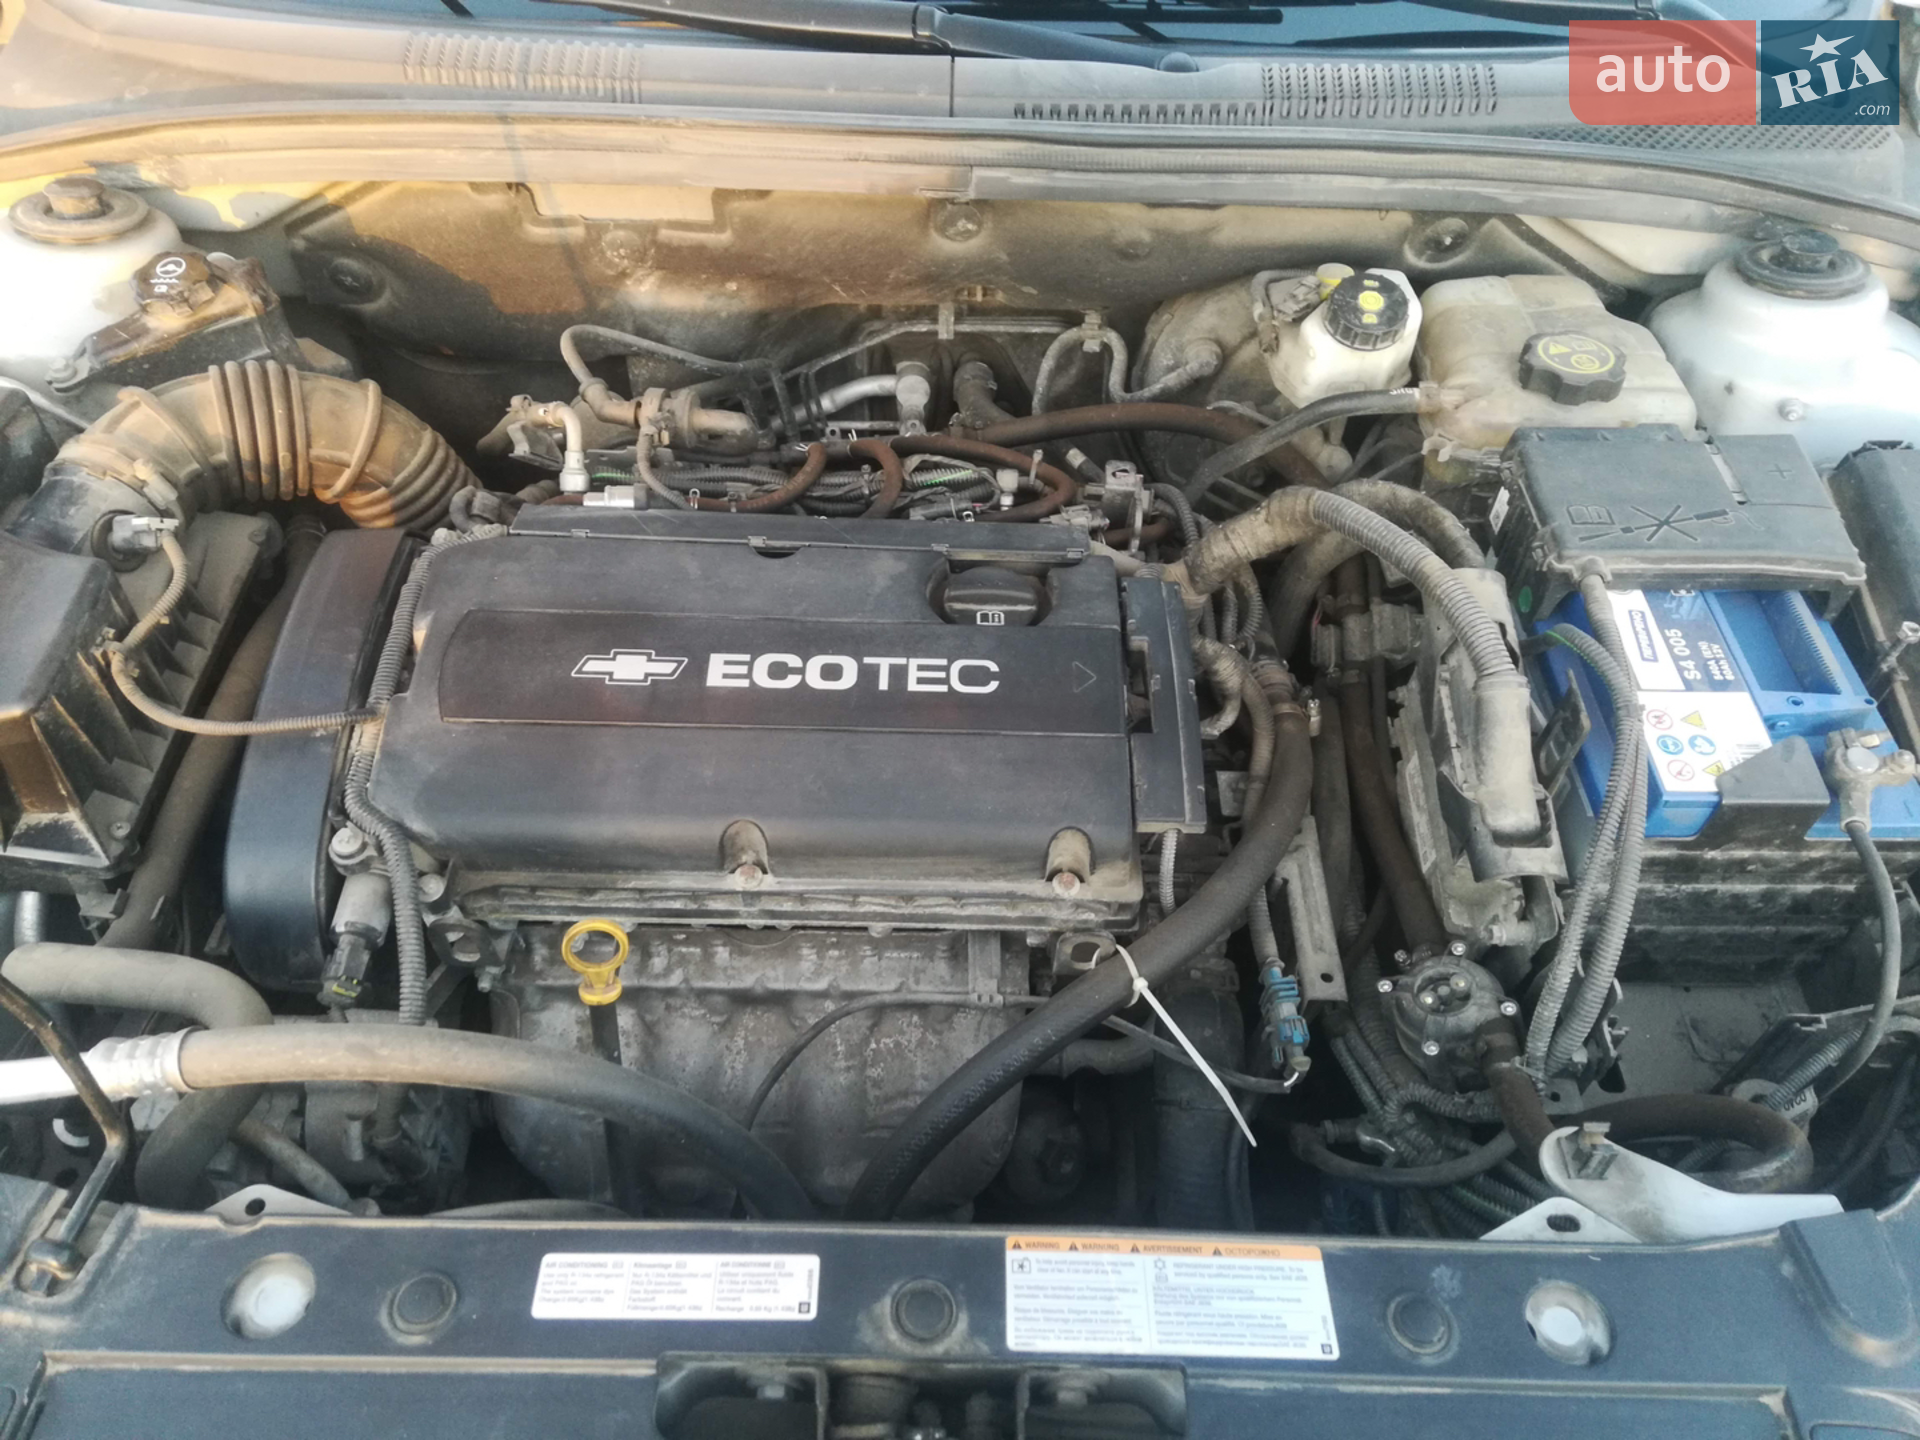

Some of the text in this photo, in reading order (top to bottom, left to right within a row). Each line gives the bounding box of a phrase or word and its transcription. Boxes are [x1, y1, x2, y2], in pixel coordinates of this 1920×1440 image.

[1664, 628, 1702, 680] S4 005
[1709, 643, 1725, 658] 12V
[706, 652, 1000, 694] ECOTEC
[1025, 1241, 1060, 1249] WARNING
[1081, 1242, 1120, 1251] WARNUNG
[1143, 1244, 1203, 1254] AVERTISSEMENT
